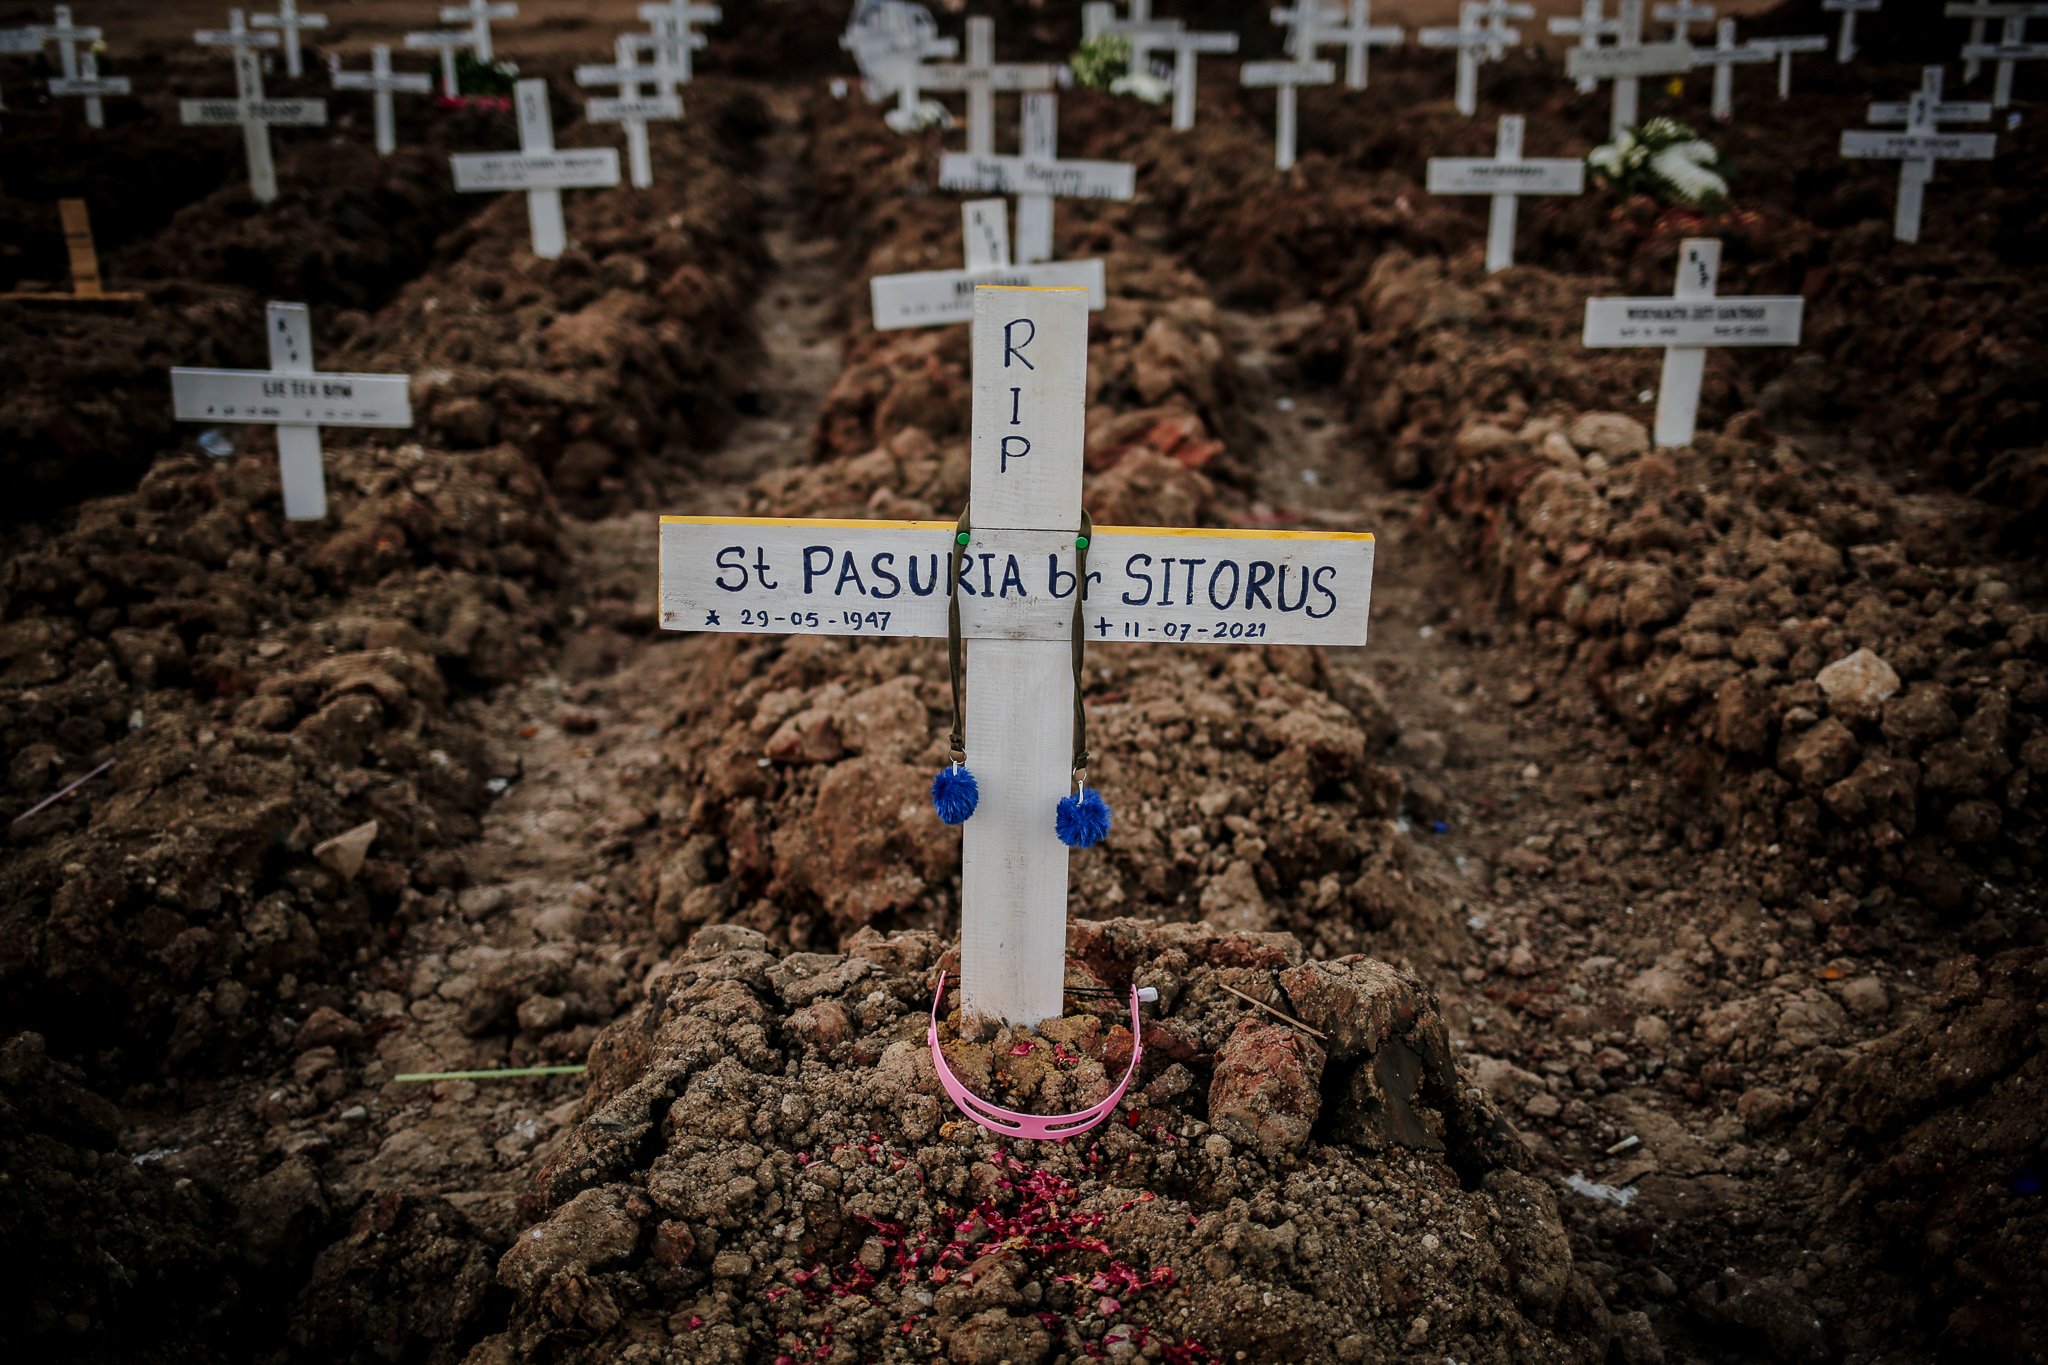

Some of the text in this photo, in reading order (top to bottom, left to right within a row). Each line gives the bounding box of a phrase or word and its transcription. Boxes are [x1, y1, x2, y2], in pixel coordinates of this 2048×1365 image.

[1001, 318, 1036, 474] RIP
[715, 545, 1337, 619] St PASURIA br SITORUS
[740, 608, 892, 631] 29-05-1947
[1123, 621, 1267, 642] 11-07-2021
